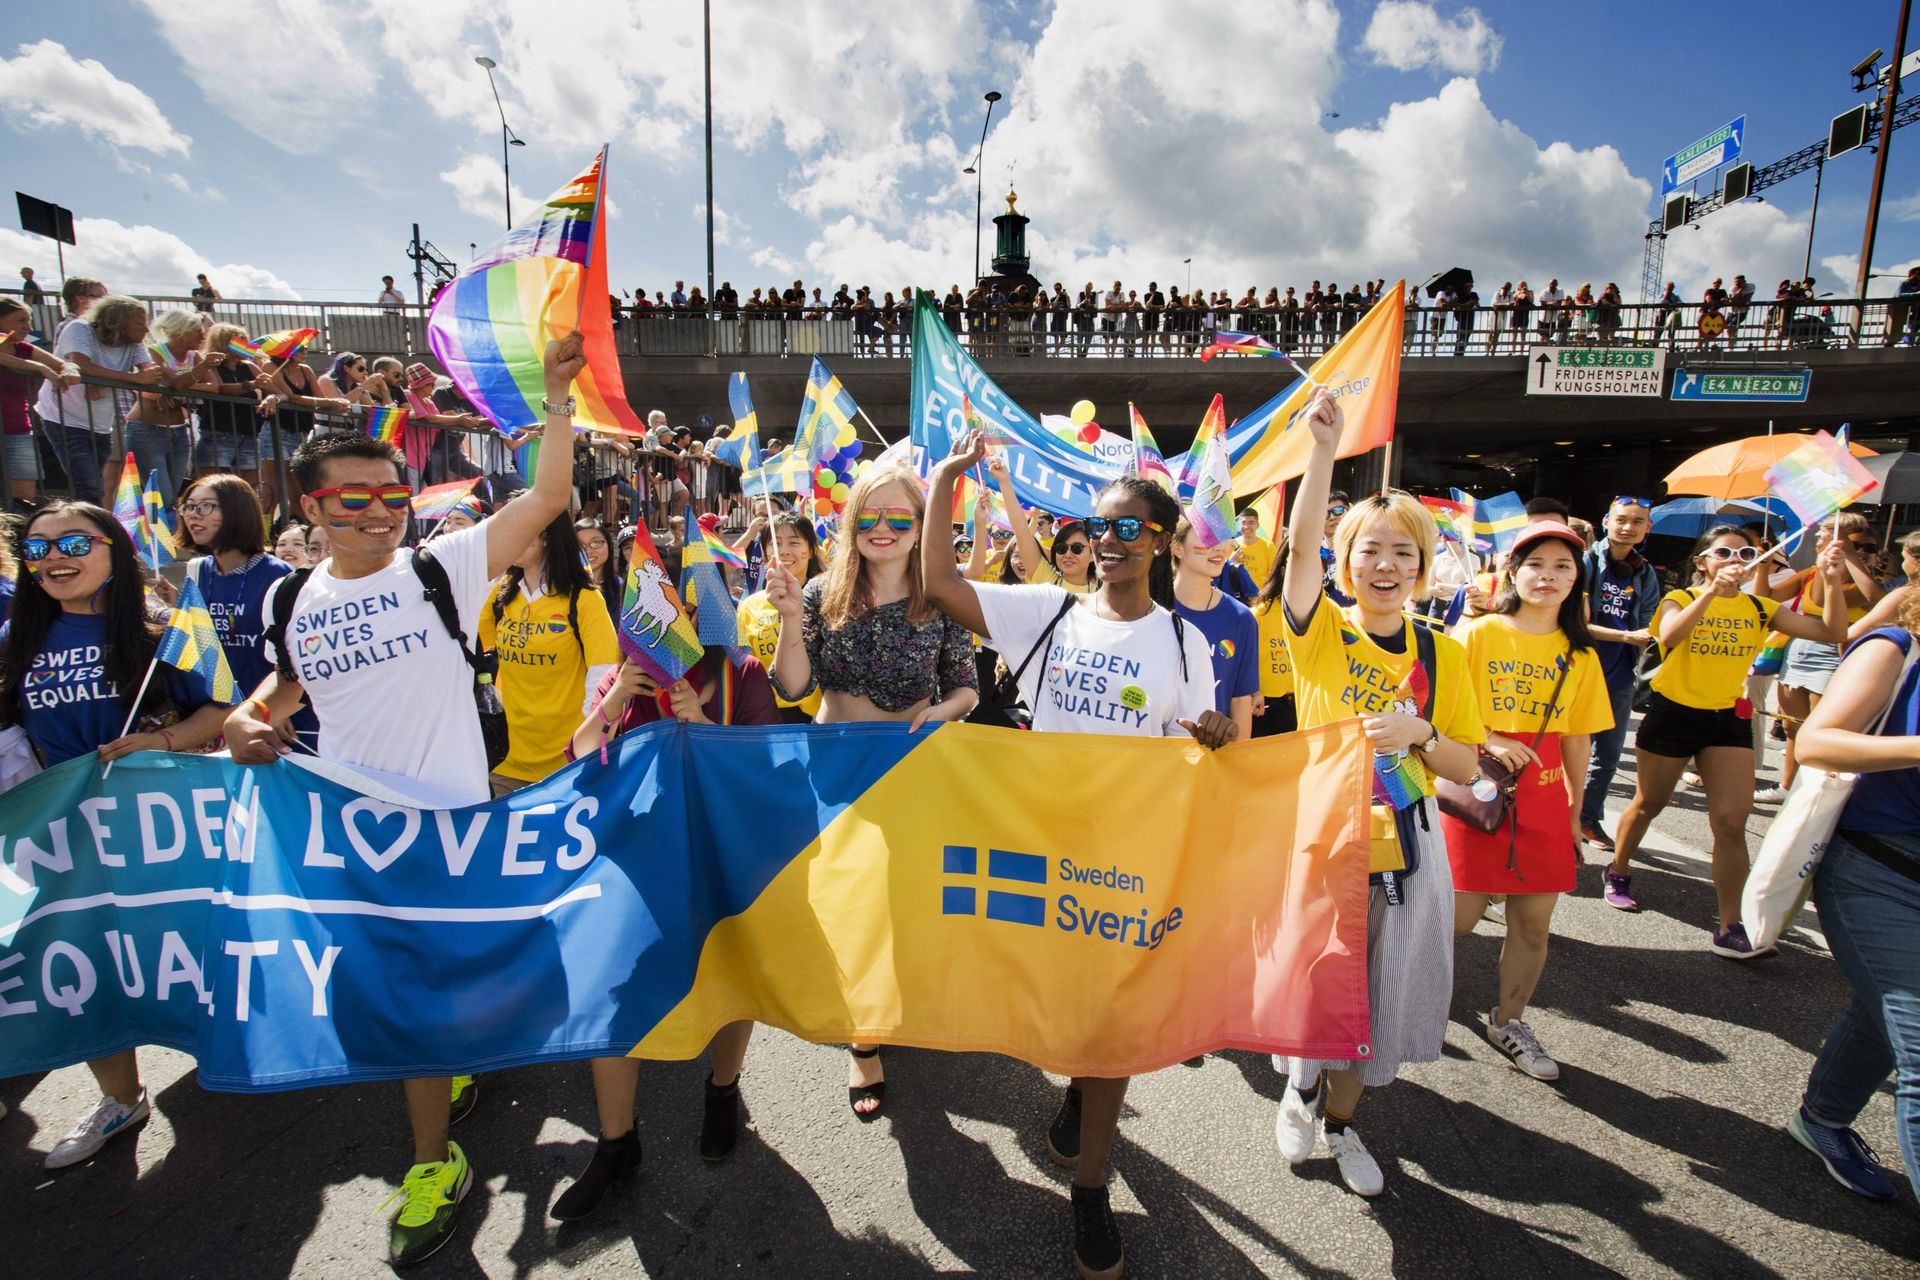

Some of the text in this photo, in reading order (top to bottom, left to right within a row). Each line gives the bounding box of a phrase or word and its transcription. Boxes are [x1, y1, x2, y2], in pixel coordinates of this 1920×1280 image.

[1563, 353, 1581, 365] E4
[1587, 353, 1596, 365] S
[1641, 354, 1650, 366] S
[1554, 381, 1659, 394] KUNGSHOLMEN
[1555, 369, 1660, 382] FRIDHEMSPLAN
[1708, 379, 1798, 393] E4 N E20 N
[296, 591, 400, 634] SWEDEN
[1697, 616, 1754, 630] SWEDEN
[302, 629, 429, 682] EQUALITY
[1050, 645, 1140, 679] SWEDEN
[1059, 858, 1144, 893] Sweden
[1056, 894, 1184, 951] Sverige
